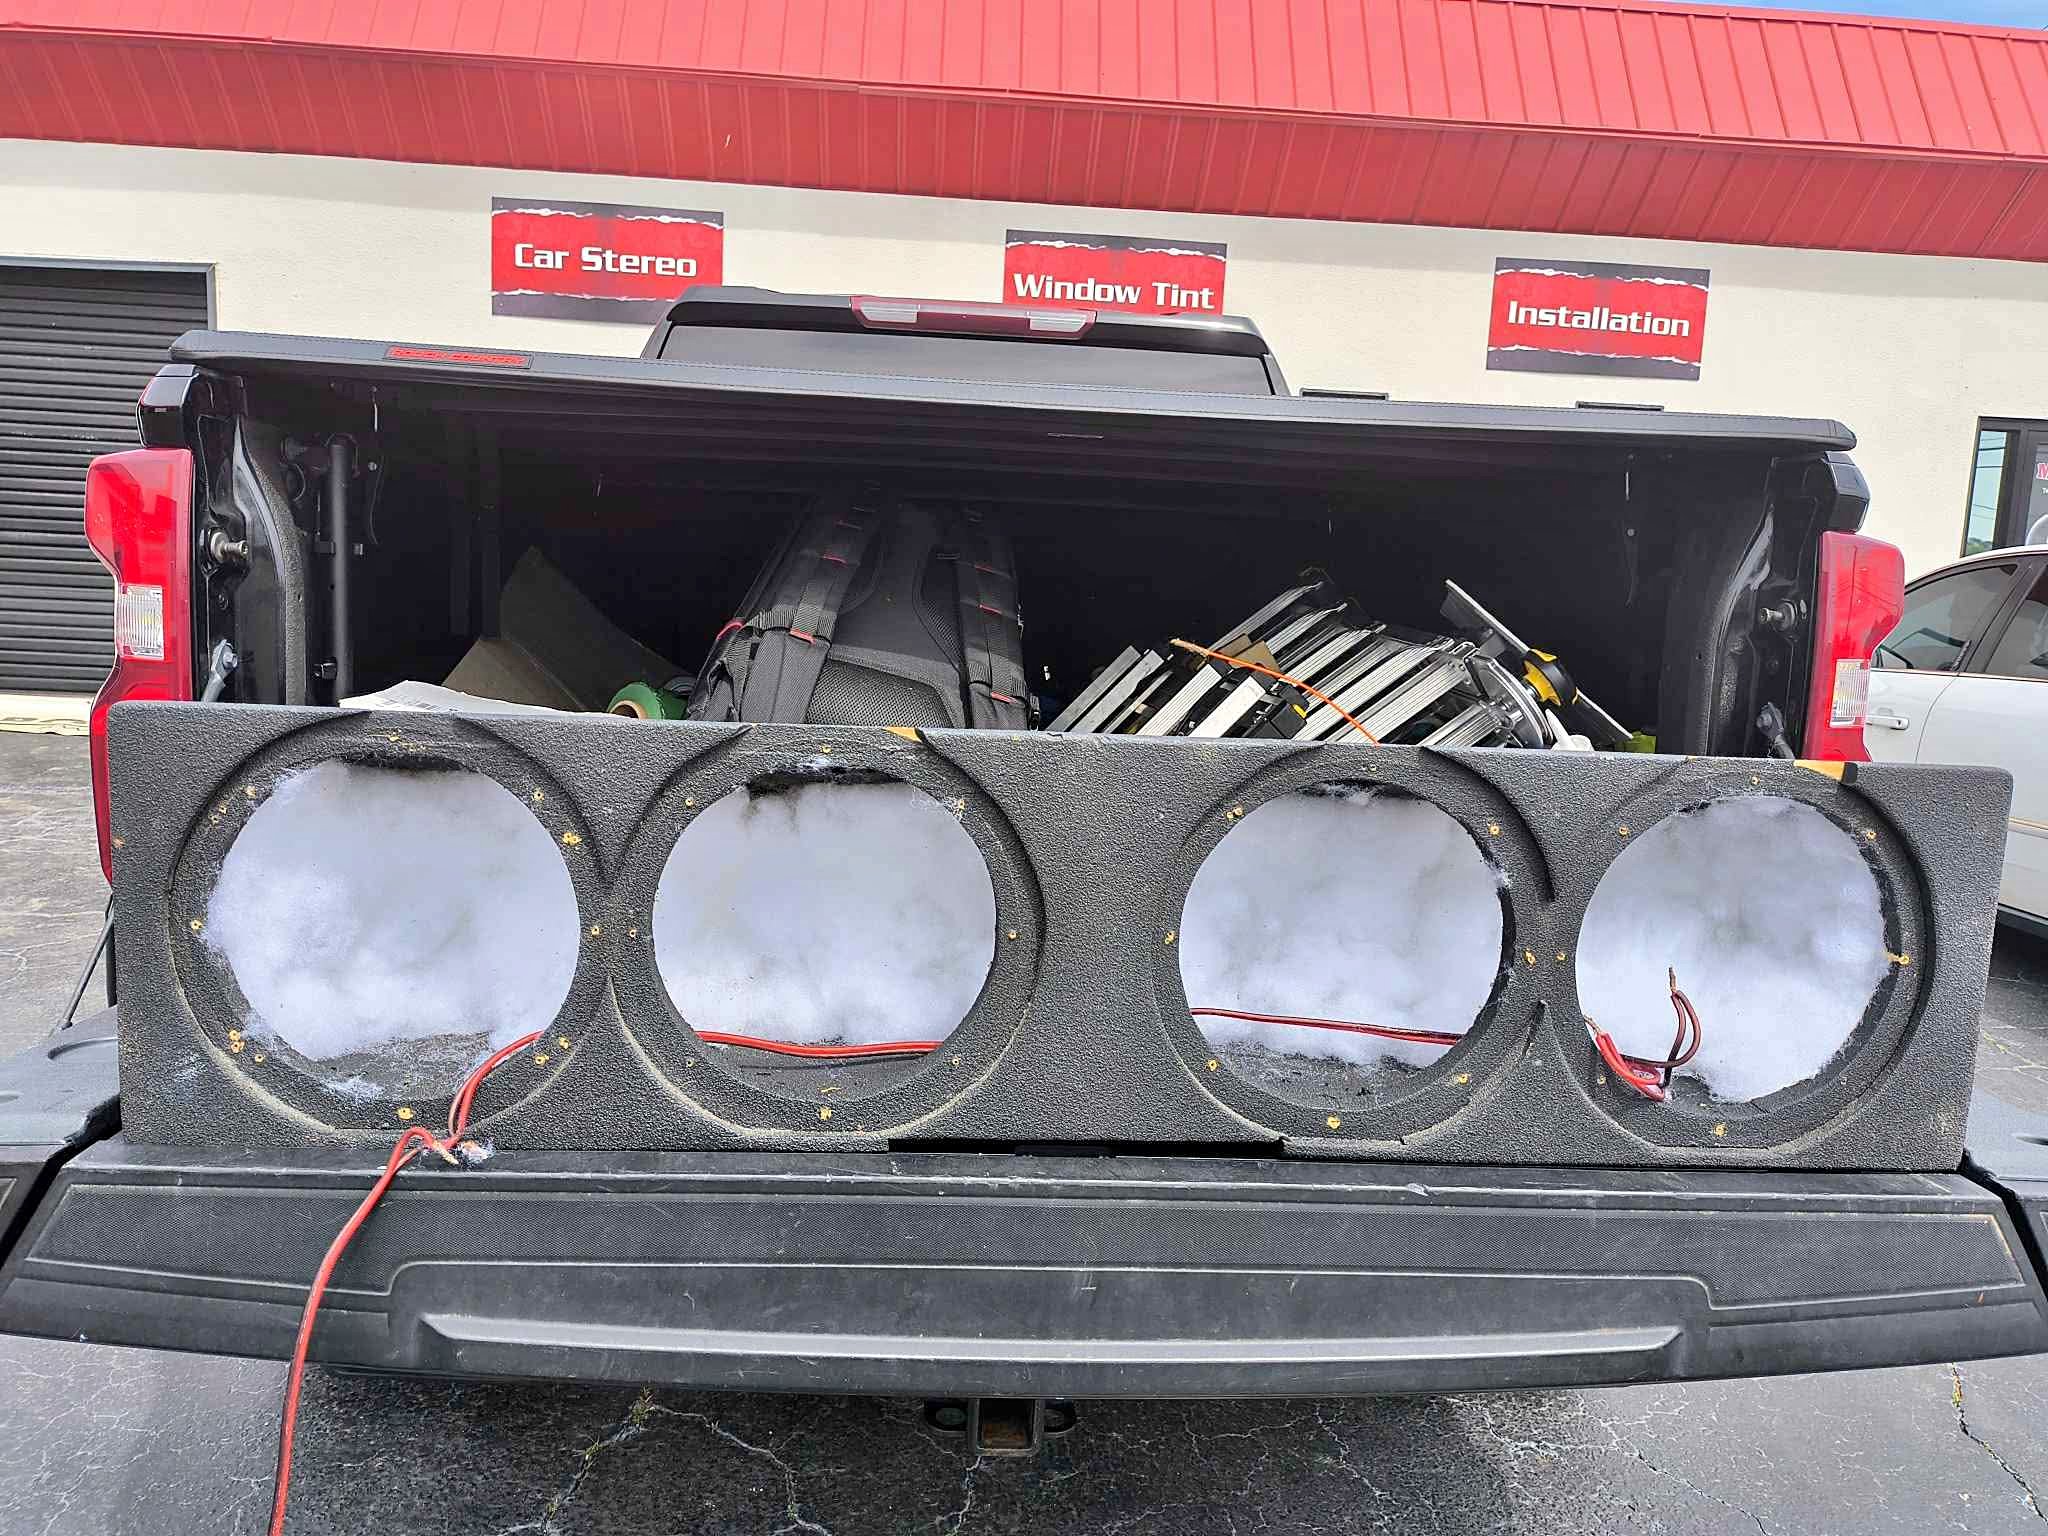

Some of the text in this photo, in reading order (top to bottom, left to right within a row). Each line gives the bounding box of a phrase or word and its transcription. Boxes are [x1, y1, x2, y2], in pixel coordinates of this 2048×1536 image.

[514, 243, 697, 277] Car Stereo
[1013, 273, 1215, 309] Window Tint
[1507, 300, 1690, 337] Installation
